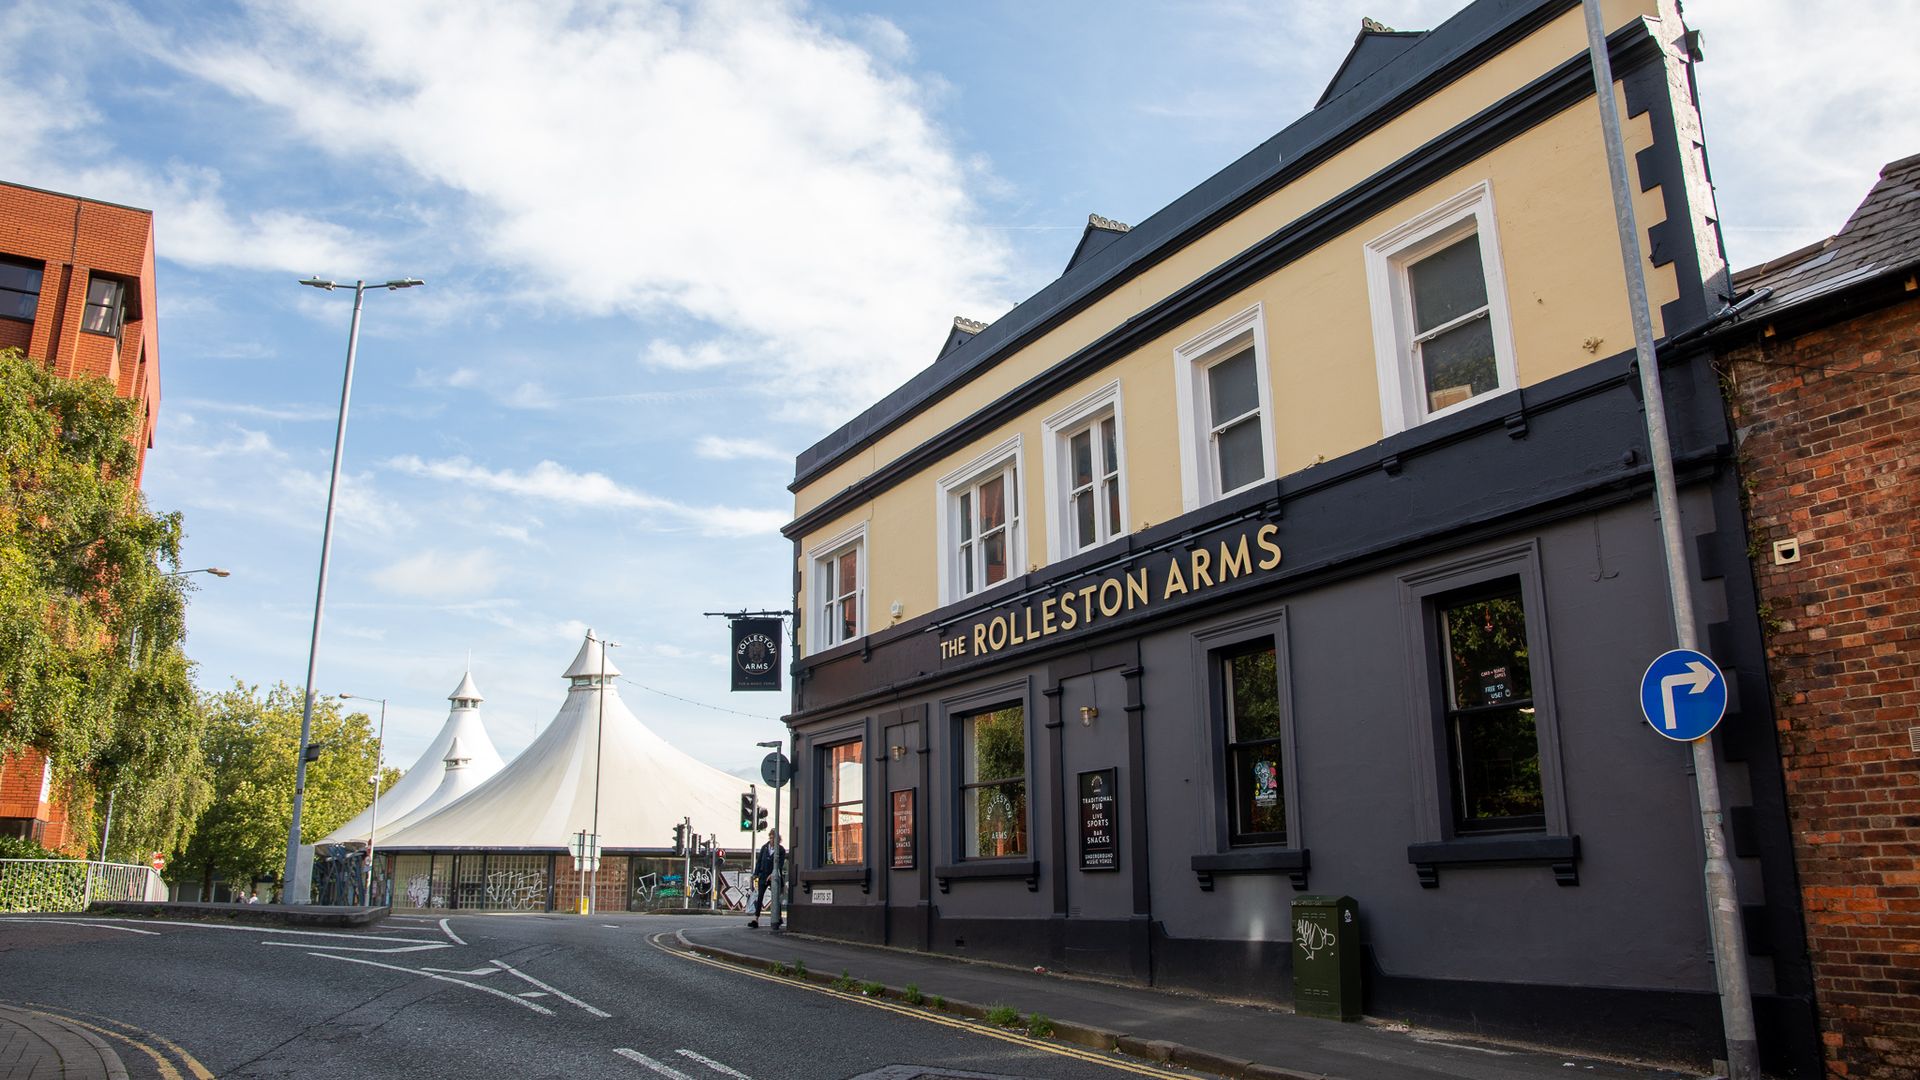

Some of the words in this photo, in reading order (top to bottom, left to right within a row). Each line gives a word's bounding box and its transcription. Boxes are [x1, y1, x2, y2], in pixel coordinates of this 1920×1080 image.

[940, 635, 967, 660] THE
[974, 568, 1149, 656] ROLLESTON
[1163, 524, 1282, 599] ARMS
[738, 635, 775, 655] ROLLESTON
[1485, 685, 1495, 693] FREE
[1082, 796, 1112, 804] TRADITIONAL
[986, 794, 1012, 820] ROLLESTON
[1087, 818, 1108, 828] SPORTS
[992, 831, 1008, 839] ARMS
[1087, 836, 1110, 844] SNACKS
